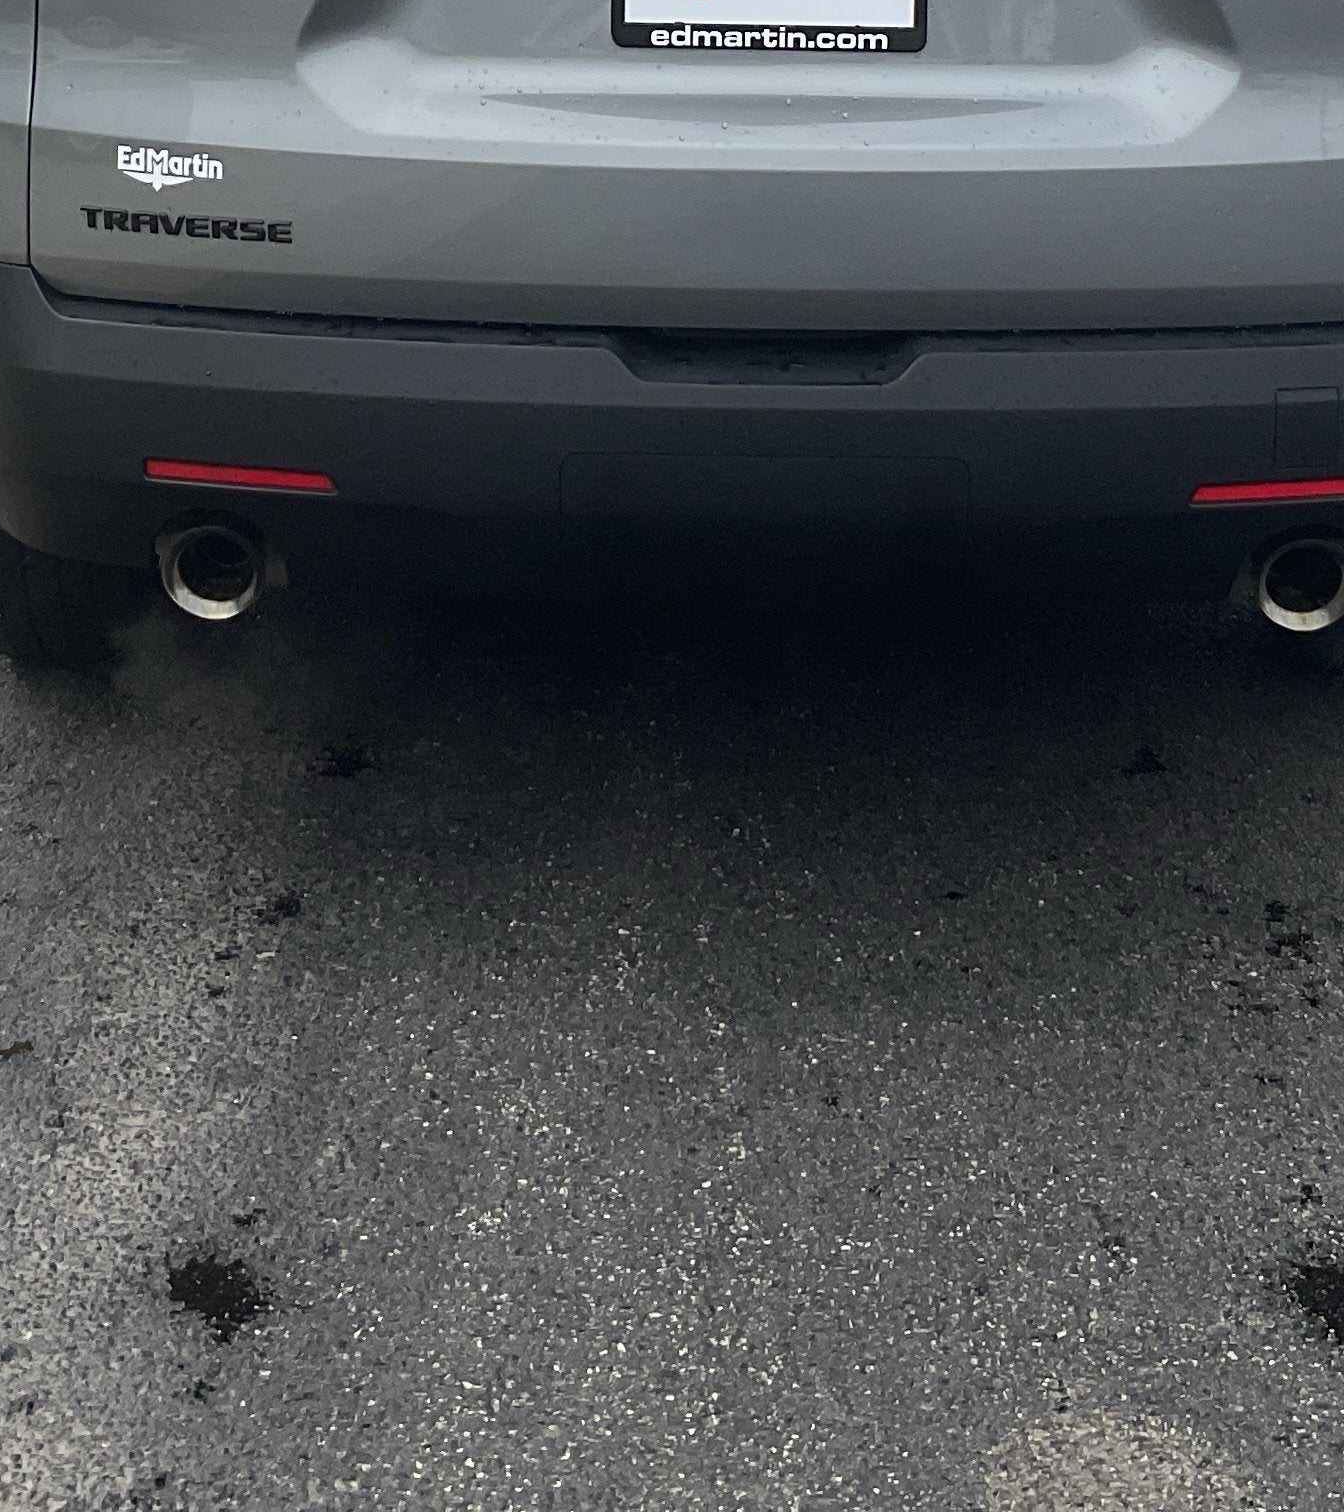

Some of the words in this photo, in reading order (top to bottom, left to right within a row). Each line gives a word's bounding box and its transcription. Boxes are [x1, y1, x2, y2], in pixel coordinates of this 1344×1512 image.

[650, 25, 889, 50] edmartin.com
[116, 143, 224, 180] EdMartin
[79, 204, 293, 244] TRAVERSE
